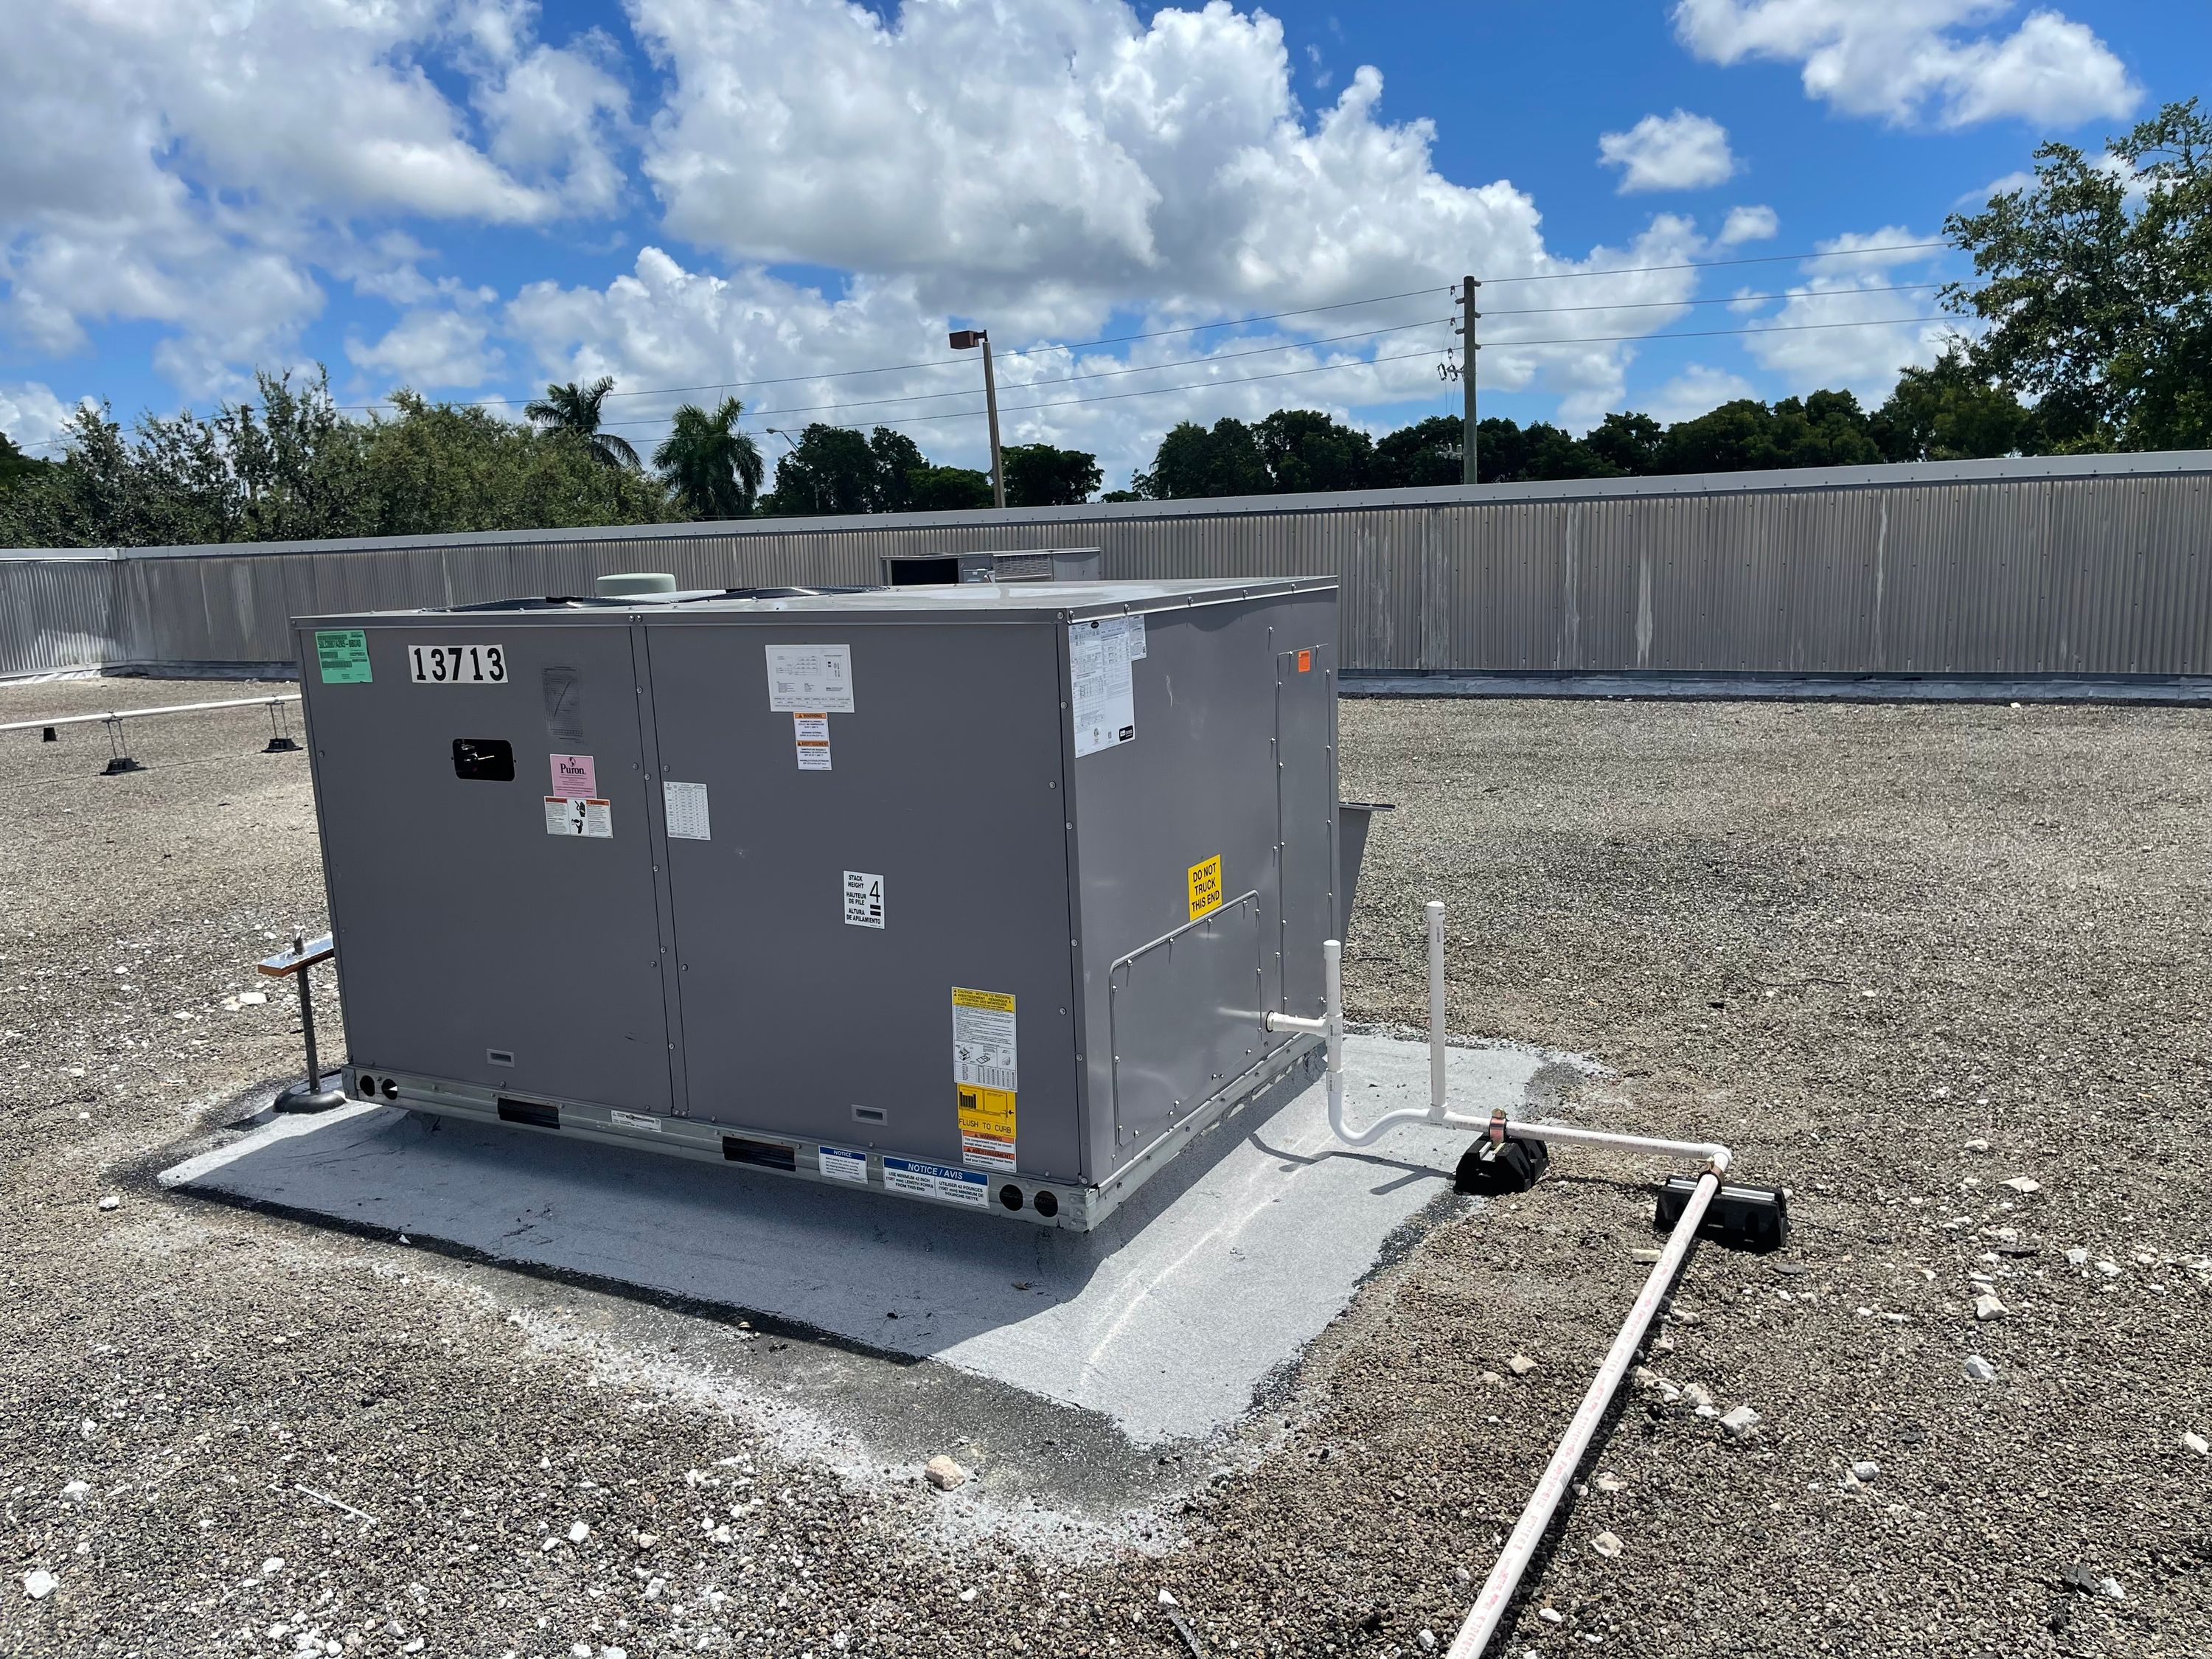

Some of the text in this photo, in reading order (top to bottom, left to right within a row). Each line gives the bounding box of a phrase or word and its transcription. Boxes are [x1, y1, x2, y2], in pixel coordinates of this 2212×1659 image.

[414, 647, 504, 681] 13713
[560, 763, 585, 775] Puron
[1193, 863, 1217, 883] DO NOT
[869, 880, 880, 903] 4
[1194, 877, 1216, 896] TRUCK
[846, 891, 867, 900] HAUTEUR
[1192, 890, 1220, 912] THIS END
[852, 915, 881, 924] APILAMIENTO
[959, 1119, 1012, 1134] FLUSH TO CURB
[833, 1150, 852, 1158] NOTICE
[908, 1163, 963, 1180] NOTICE / AVIS
